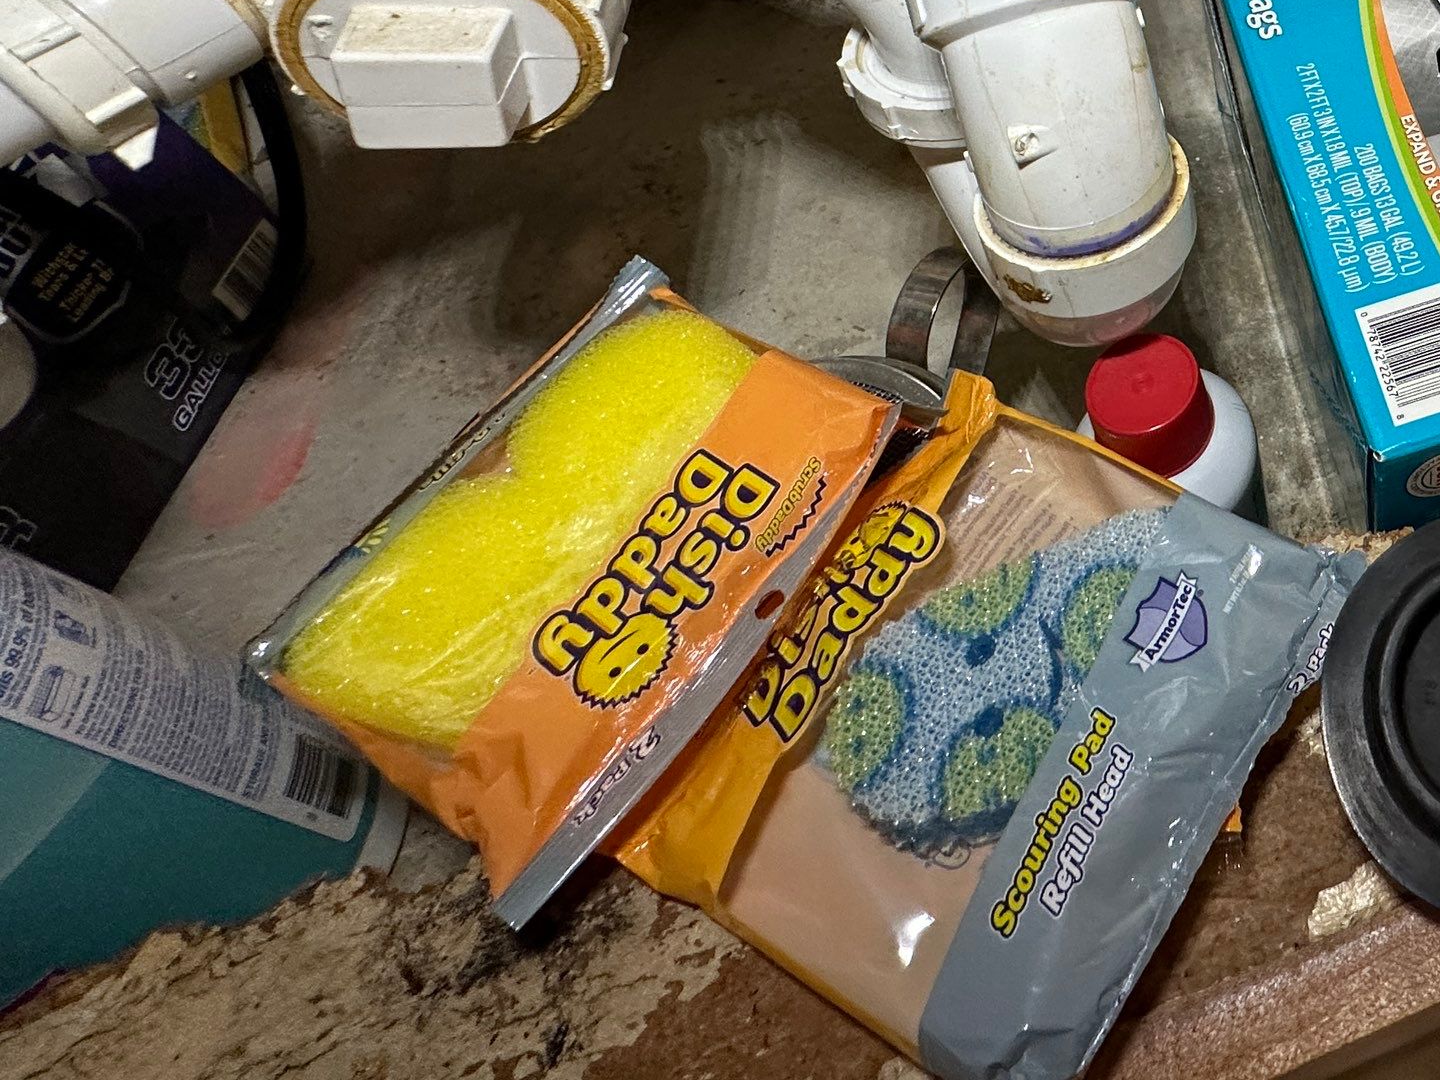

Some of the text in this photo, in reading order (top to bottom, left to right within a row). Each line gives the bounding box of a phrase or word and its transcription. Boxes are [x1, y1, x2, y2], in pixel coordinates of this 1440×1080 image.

[1285, 111, 1315, 140] (60.9
[1297, 139, 1315, 156] cm
[1323, 134, 1346, 151] 1.8
[1400, 114, 1437, 175] EXPAND
[1302, 153, 1323, 164] X
[1305, 161, 1331, 188] 68.5
[1329, 150, 1354, 172] MIL
[1313, 187, 1333, 205] cm
[1319, 202, 1340, 214] X
[1353, 142, 1425, 277] 200 BAGS 13 GAL (49.2 L)
[1322, 211, 1360, 266] 45.7/22.8
[1353, 216, 1380, 240] MIL
[1360, 239, 1399, 285] (BODY)
[172, 345, 229, 431] GALLO
[1366, 328, 1385, 361] 78742
[1378, 364, 1398, 398] 22567
[532, 448, 734, 677] Daddy
[639, 460, 781, 623] Dish
[764, 504, 942, 743] Daddy
[1145, 584, 1192, 660] ArmorTec
[573, 725, 661, 827] 2 Pack
[989, 706, 1117, 940] Scouring Pad
[1039, 744, 1134, 916] Refill Head
